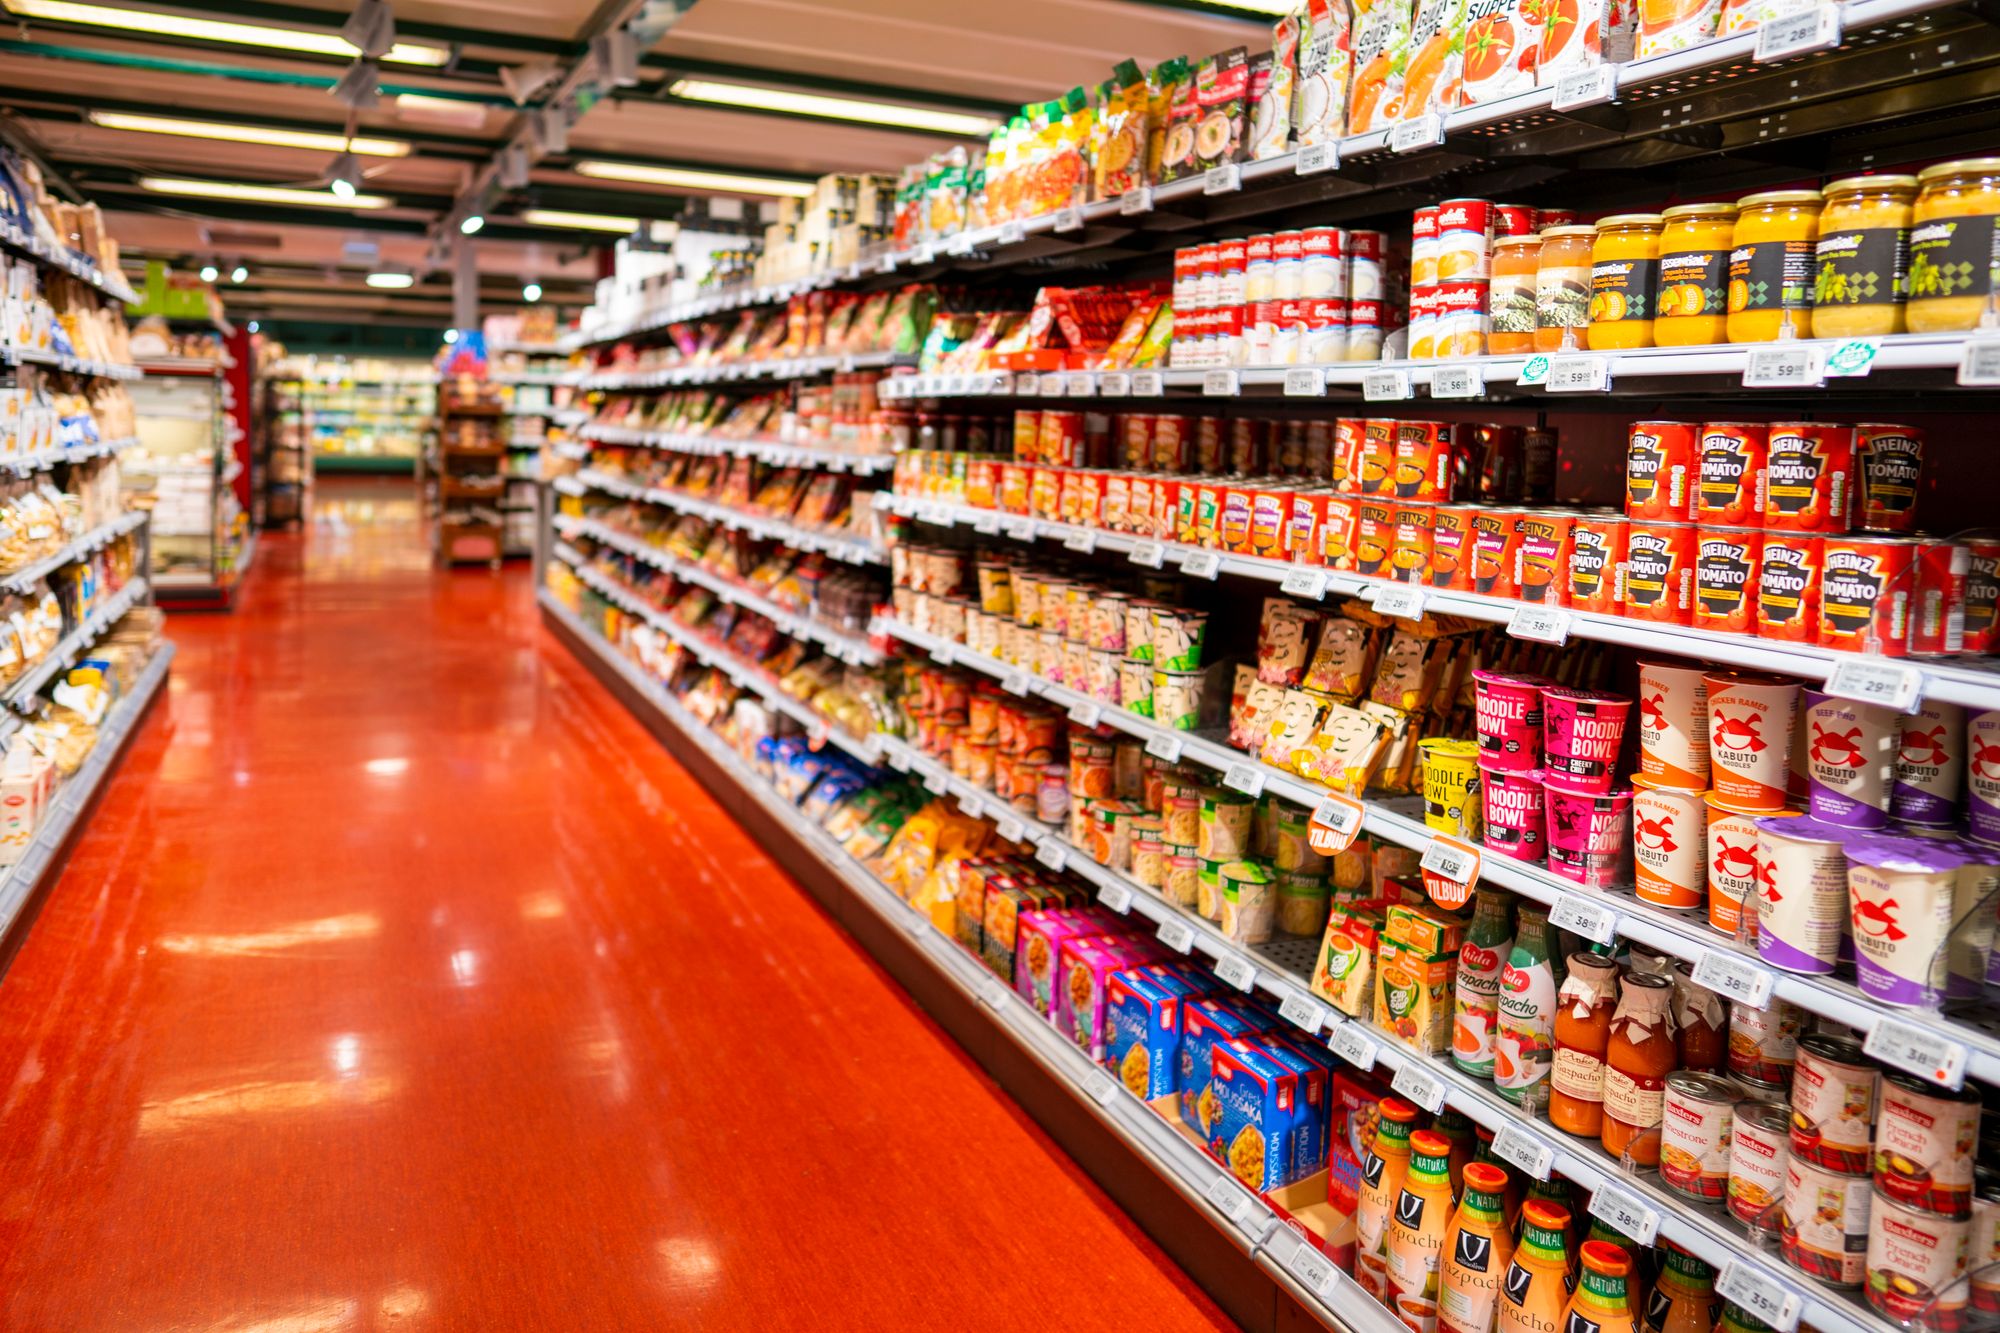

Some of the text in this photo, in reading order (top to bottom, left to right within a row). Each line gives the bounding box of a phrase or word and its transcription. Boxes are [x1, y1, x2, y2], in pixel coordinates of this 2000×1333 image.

[1778, 365, 1793, 376] 59
[1366, 426, 1388, 440] EINZ
[1400, 426, 1426, 441] EINZ
[1704, 436, 1739, 452] HEINZ
[1772, 437, 1814, 454] HEINZ
[1876, 437, 1919, 455] HEINZ
[1768, 464, 1817, 480] TOMATO
[1868, 463, 1919, 480] TOMATO
[1361, 507, 1387, 522] EINZ
[1436, 513, 1458, 530] EINZ
[1478, 517, 1500, 534] EINZ
[1524, 522, 1552, 539] EINZ
[1631, 534, 1664, 552] HEINZ
[1703, 543, 1742, 560] HEINZ
[1765, 546, 1800, 565] HEINZ
[1828, 553, 1874, 573] HEINZ
[1698, 567, 1746, 584] TOMATO
[1824, 580, 1877, 600] TOMATO
[1865, 681, 1885, 693] 29
[1477, 695, 1525, 720] NOODLE
[1738, 698, 1769, 712] RAMEN
[1477, 712, 1508, 737] BOWL
[1572, 718, 1625, 742] NOODLE
[1571, 737, 1612, 759] BOWL
[1717, 750, 1758, 763] KABUTO
[1570, 758, 1592, 768] CHEEKY
[1722, 760, 1751, 769] NOODLES
[1814, 764, 1857, 779] KABUTO
[1819, 775, 1849, 785] NOODLES
[1975, 778, 2000, 793] KABU
[1488, 785, 1542, 811] NOODLE
[1488, 806, 1527, 828] BOWL
[1652, 801, 1680, 817] RAMEN
[1309, 828, 1349, 851] TILBUD
[1637, 847, 1669, 863] KABUTO
[1426, 878, 1466, 903] TILBUD
[1575, 915, 1589, 929] 38
[1857, 932, 1896, 953] KABUTO
[1464, 945, 1491, 966] hida
[1724, 976, 1741, 990] 38
[1907, 1048, 1927, 1065] 38
[1557, 1061, 1601, 1082] Gazpacho
[1666, 1101, 1701, 1126] Baxters
[1886, 1117, 1928, 1145] French
[1736, 1132, 1775, 1158] Baxters
[1886, 1132, 1923, 1154] Onion
[1515, 1148, 1529, 1162] 108
[1416, 1156, 1447, 1172] NATURAL
[1617, 1211, 1631, 1226] 38
[1526, 1225, 1561, 1247] NATURAL
[1883, 1217, 1937, 1249] Baxters
[1885, 1238, 1931, 1265] French
[1887, 1250, 1927, 1274] Onion
[1589, 1276, 1625, 1294] NATURAL
[1751, 1292, 1768, 1310] 35
